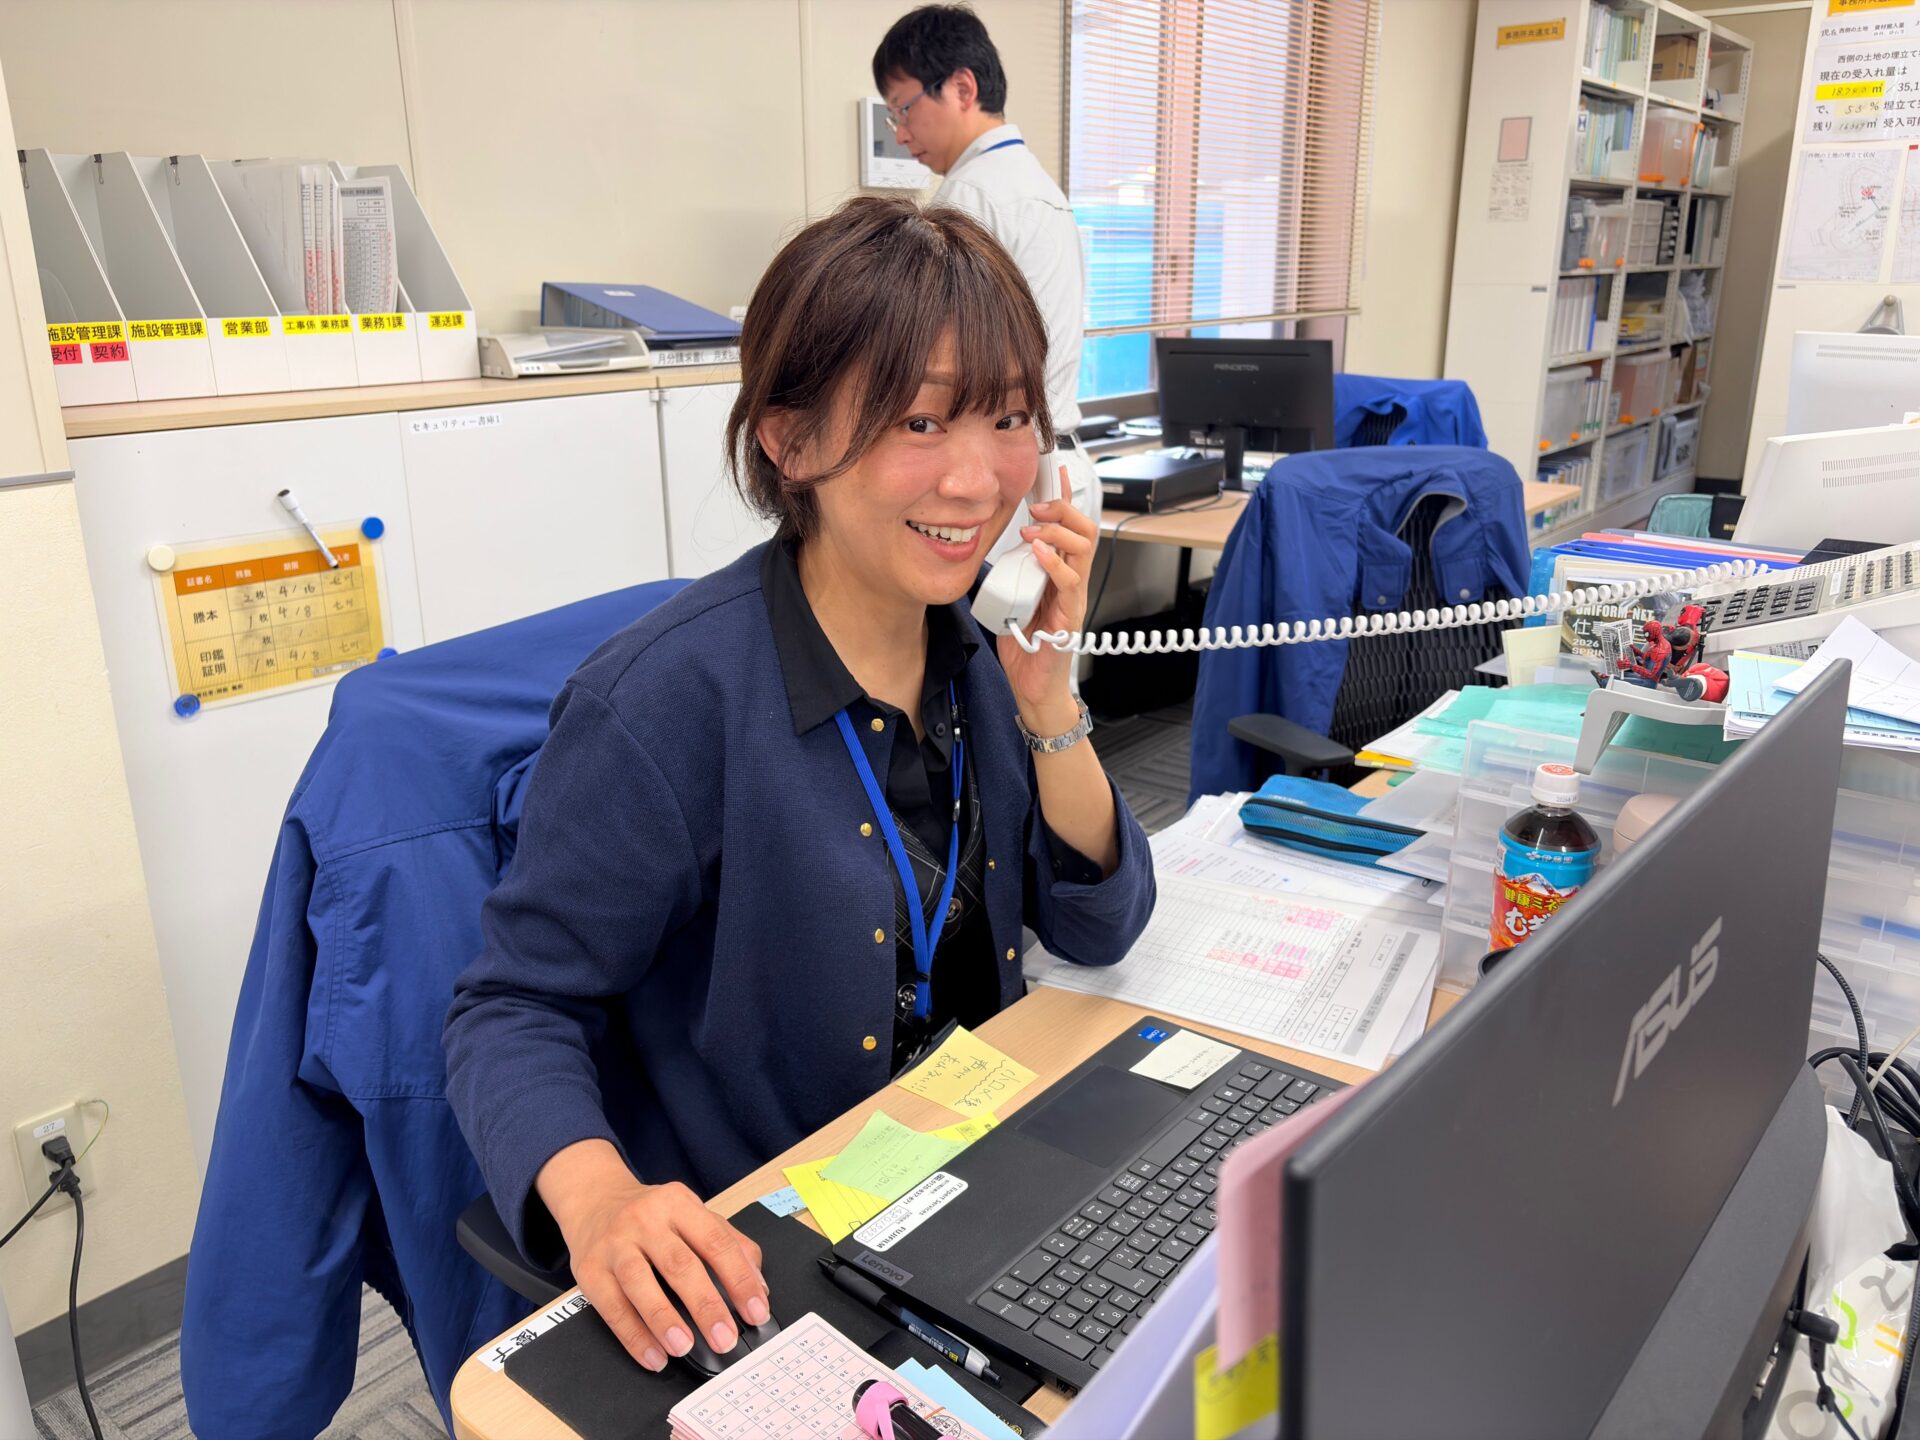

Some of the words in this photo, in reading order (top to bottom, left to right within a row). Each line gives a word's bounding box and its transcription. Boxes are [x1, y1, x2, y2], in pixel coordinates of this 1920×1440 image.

[286, 320, 316, 330] 工事係
[320, 318, 350, 329] 業務課
[362, 316, 404, 330] 業務1課
[430, 315, 462, 328] 運送課
[48, 324, 122, 342] 施設管理課
[130, 322, 204, 338] 施設管理課
[225, 320, 268, 335] 営業部
[52, 346, 78, 362] 受付
[94, 345, 126, 360] 契約
[1572, 638, 1600, 648] 2026
[200, 648, 225, 664] 印鑑
[1572, 647, 1605, 658] SPRIN
[202, 662, 227, 678] 証明
[1612, 916, 1723, 1107] ASUS
[877, 1226, 906, 1248] FUJIFILM
[1080, 1254, 1091, 1263] Shift
[860, 1254, 904, 1282] Lenovo
[1133, 1278, 1144, 1288] Enter
[999, 1303, 1012, 1314] Enter
[800, 1339, 809, 1347] 46
[776, 1356, 785, 1364] 47
[794, 1371, 804, 1379] 42
[816, 1387, 825, 1395] 37
[836, 1402, 846, 1411] 32
[717, 1424, 728, 1432] 45
[764, 1421, 775, 1429] 39
[811, 1420, 821, 1428] 33
